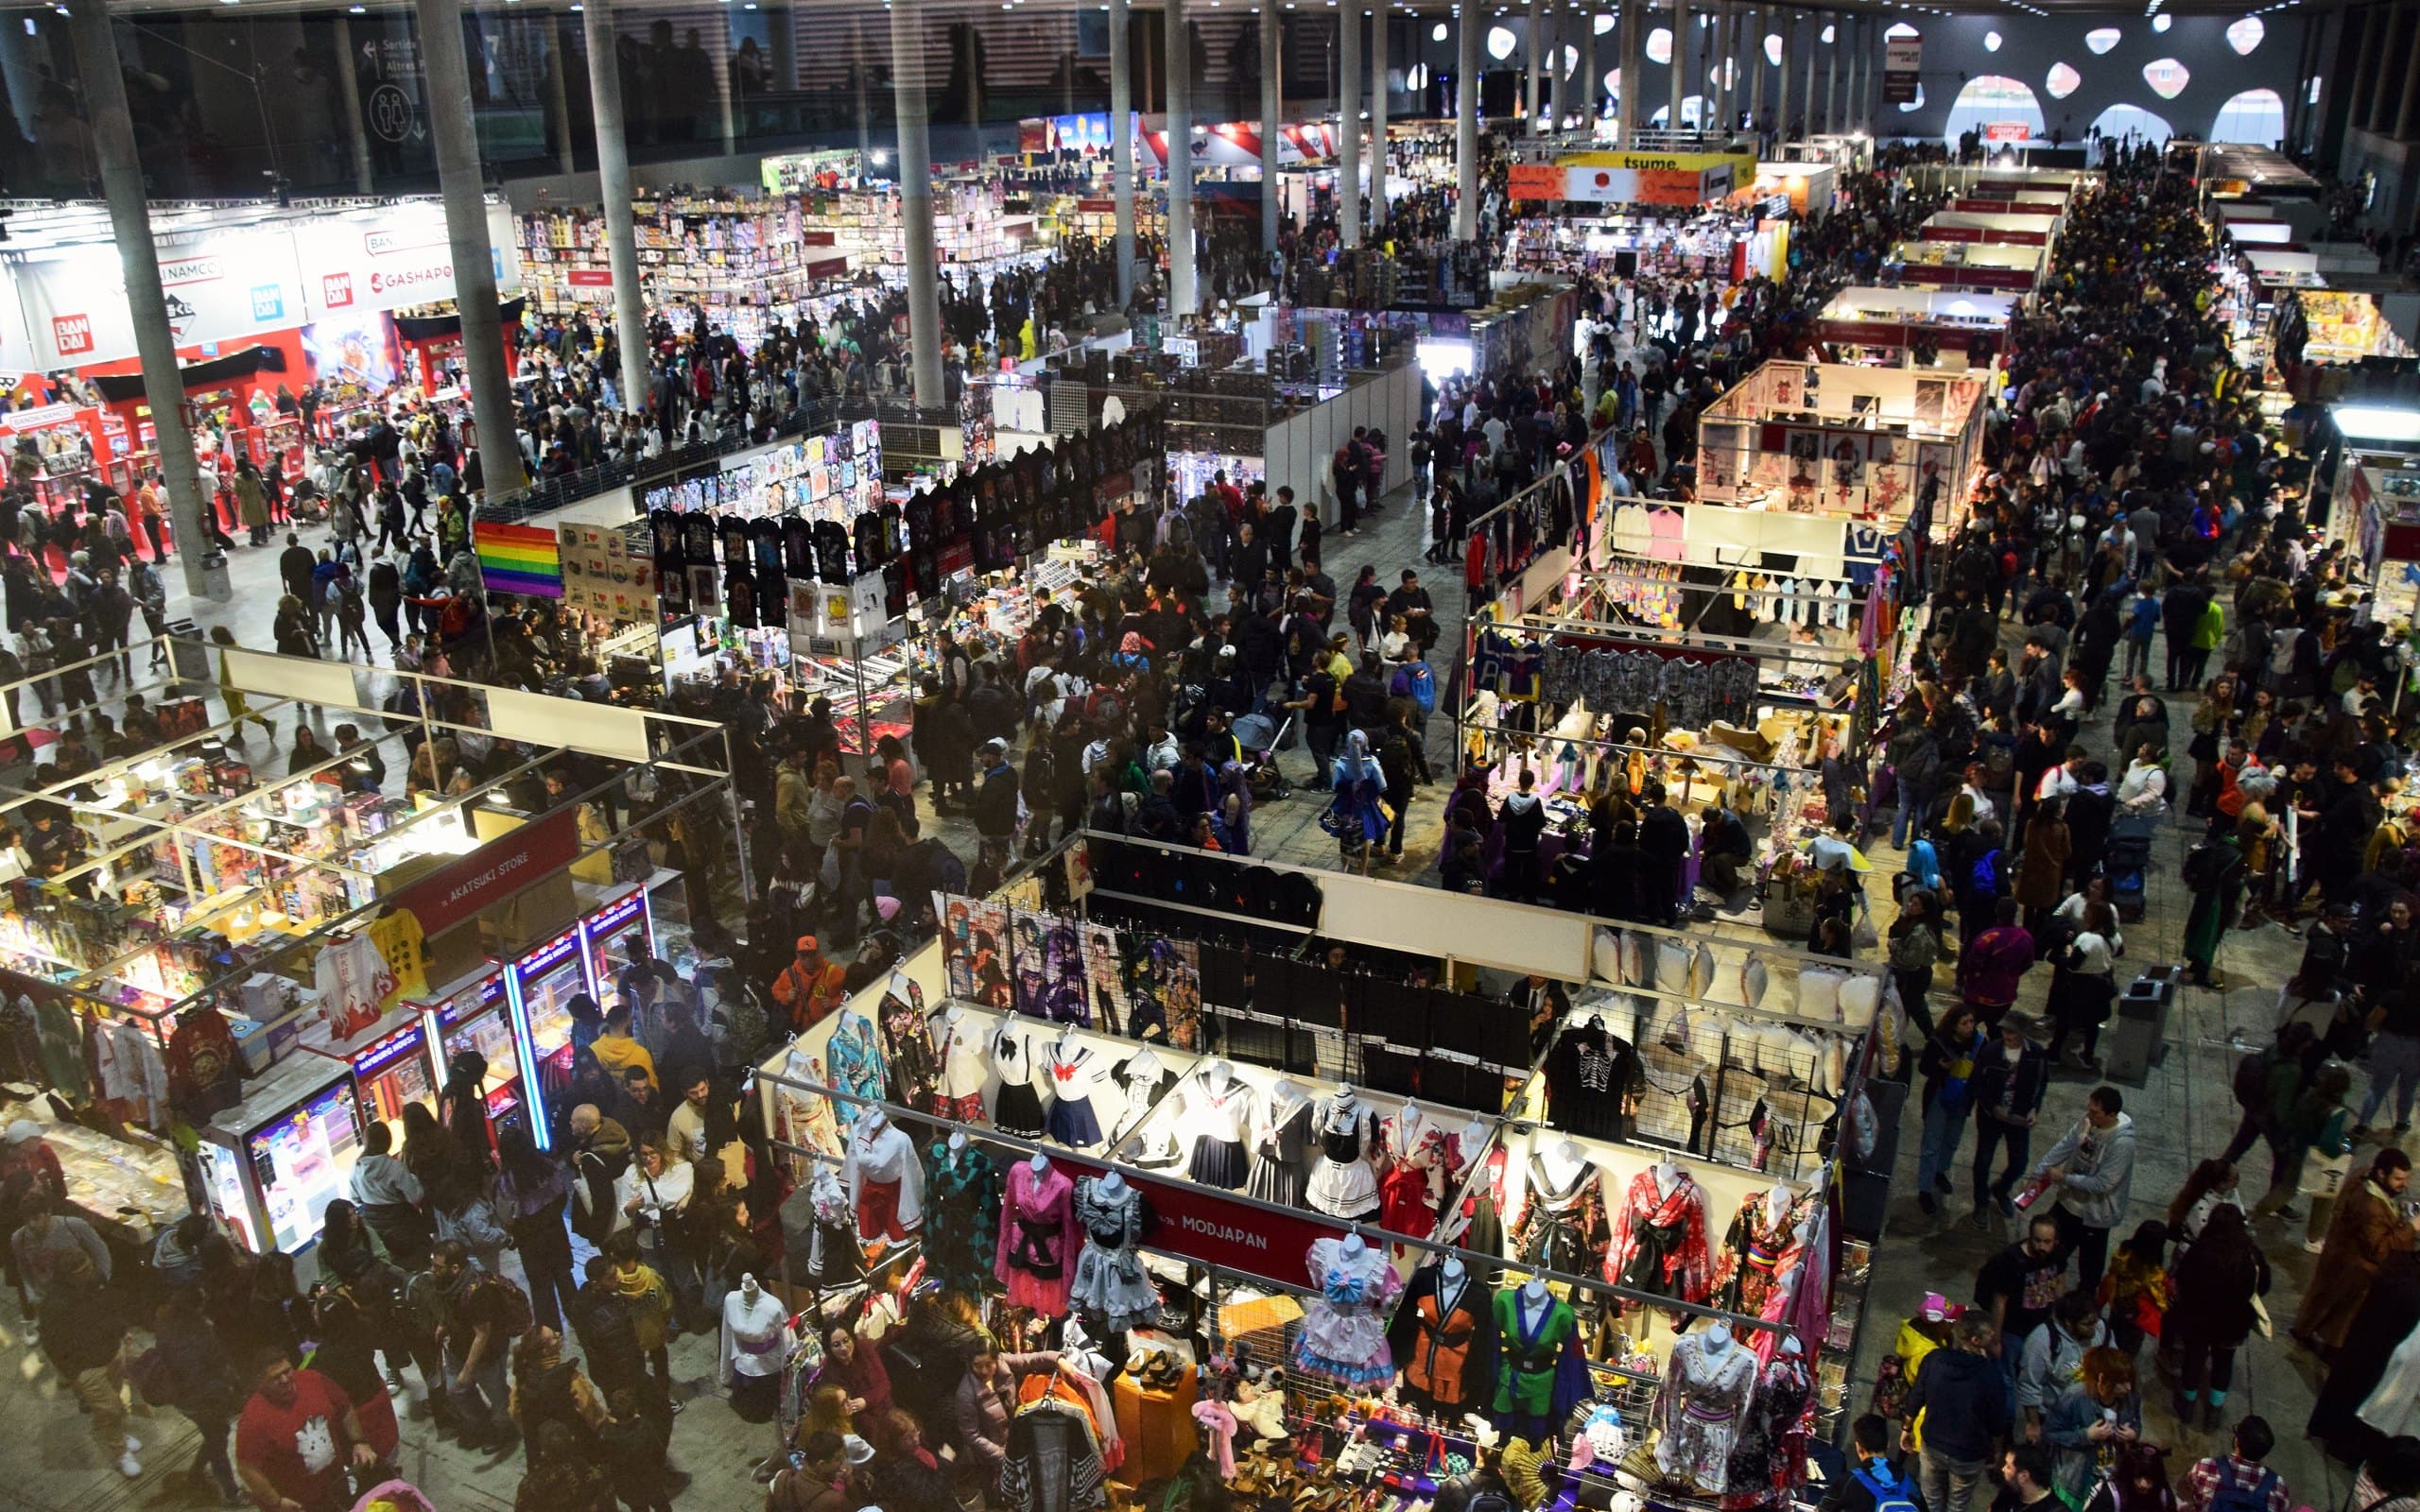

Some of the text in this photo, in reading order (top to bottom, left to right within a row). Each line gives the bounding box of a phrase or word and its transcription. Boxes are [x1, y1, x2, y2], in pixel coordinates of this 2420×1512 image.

[168, 263, 216, 280] NAMCO
[386, 266, 453, 286] GASHAPO
[324, 276, 351, 290] BAN
[252, 286, 281, 302] BAN
[327, 289, 348, 303] DAI
[255, 300, 277, 317] DAI
[57, 319, 88, 335] BAN
[59, 333, 86, 351] DAI
[450, 851, 529, 902] AKATSUKI STORE
[618, 902, 638, 919] HOUSE
[524, 941, 574, 974] HAMBURG HOUSE
[358, 1033, 417, 1072] HAMBURG HOUSE
[1182, 1214, 1267, 1250] MODJAPAN
